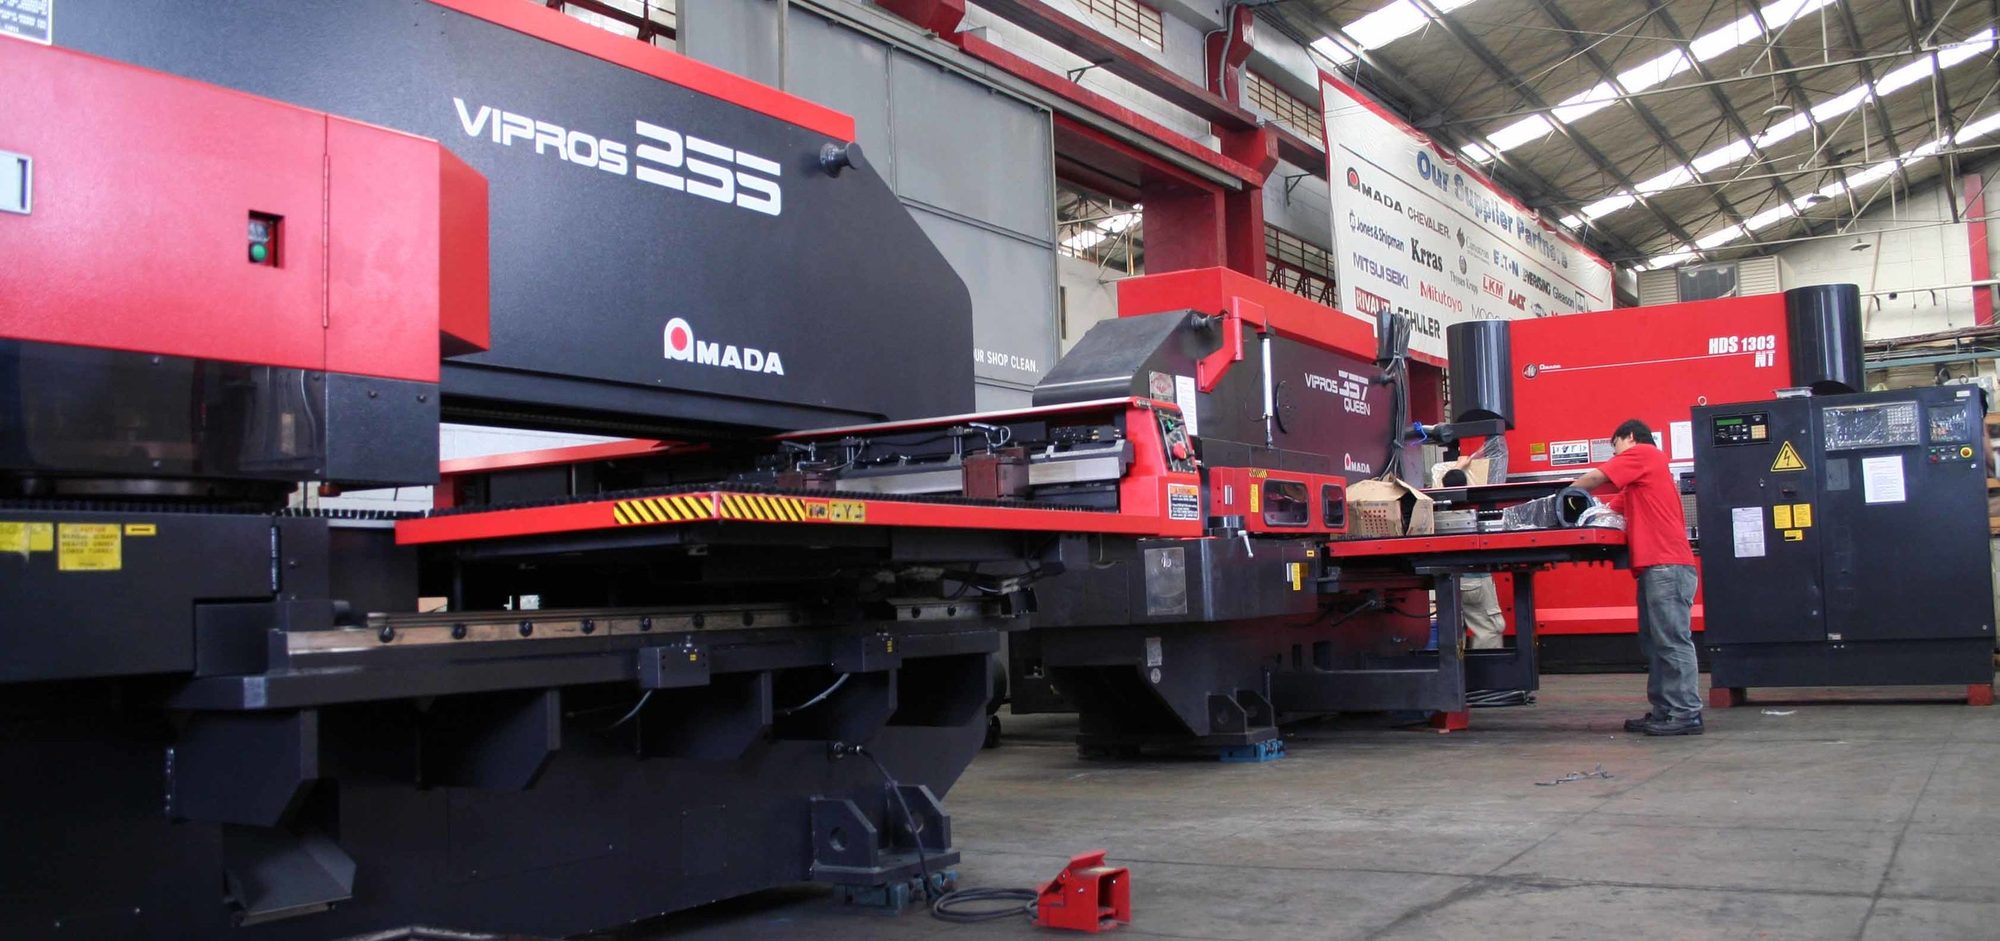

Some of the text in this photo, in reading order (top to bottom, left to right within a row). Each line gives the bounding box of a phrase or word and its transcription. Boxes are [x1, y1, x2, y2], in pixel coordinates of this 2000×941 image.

[453, 97, 782, 217] VIPROS 255
[1346, 166, 1404, 215] AMADA
[1417, 151, 1568, 269] Our Supplier Partners
[1353, 251, 1385, 280] MITSUI
[1385, 269, 1409, 290] SEIKI
[1420, 281, 1463, 313] Mitutoyo
[1410, 237, 1443, 272] Krras
[1482, 276, 1504, 297] LKM
[664, 317, 785, 376] AMADA
[986, 351, 1009, 367] SHOP
[1011, 355, 1039, 373] CLEAN.
[1708, 335, 1776, 355] HDS 1303
[1754, 350, 1776, 368] NT
[1304, 372, 1338, 394] VIPROS
[1343, 398, 1371, 416] QUEEN
[1344, 452, 1371, 474] AMADA
